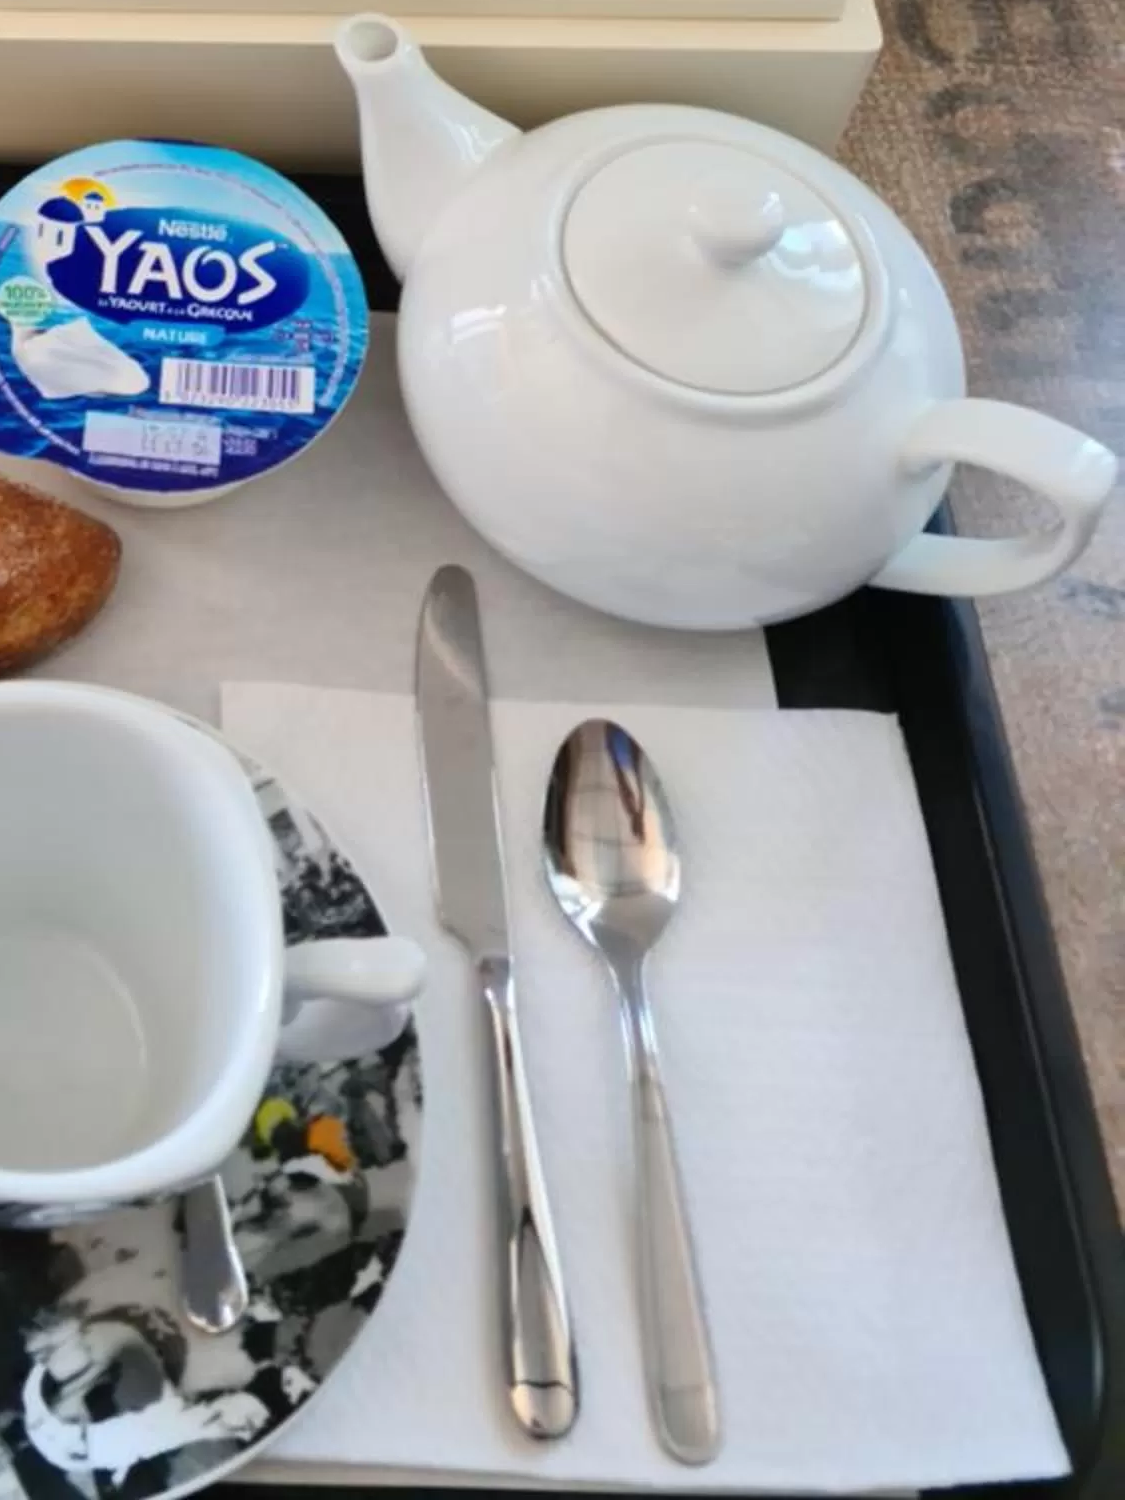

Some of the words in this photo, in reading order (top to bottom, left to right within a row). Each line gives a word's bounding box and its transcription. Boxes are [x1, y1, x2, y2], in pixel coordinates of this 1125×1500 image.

[158, 217, 228, 243] Nestlé
[83, 224, 278, 306] YAOS
[142, 327, 208, 346] NATURE
